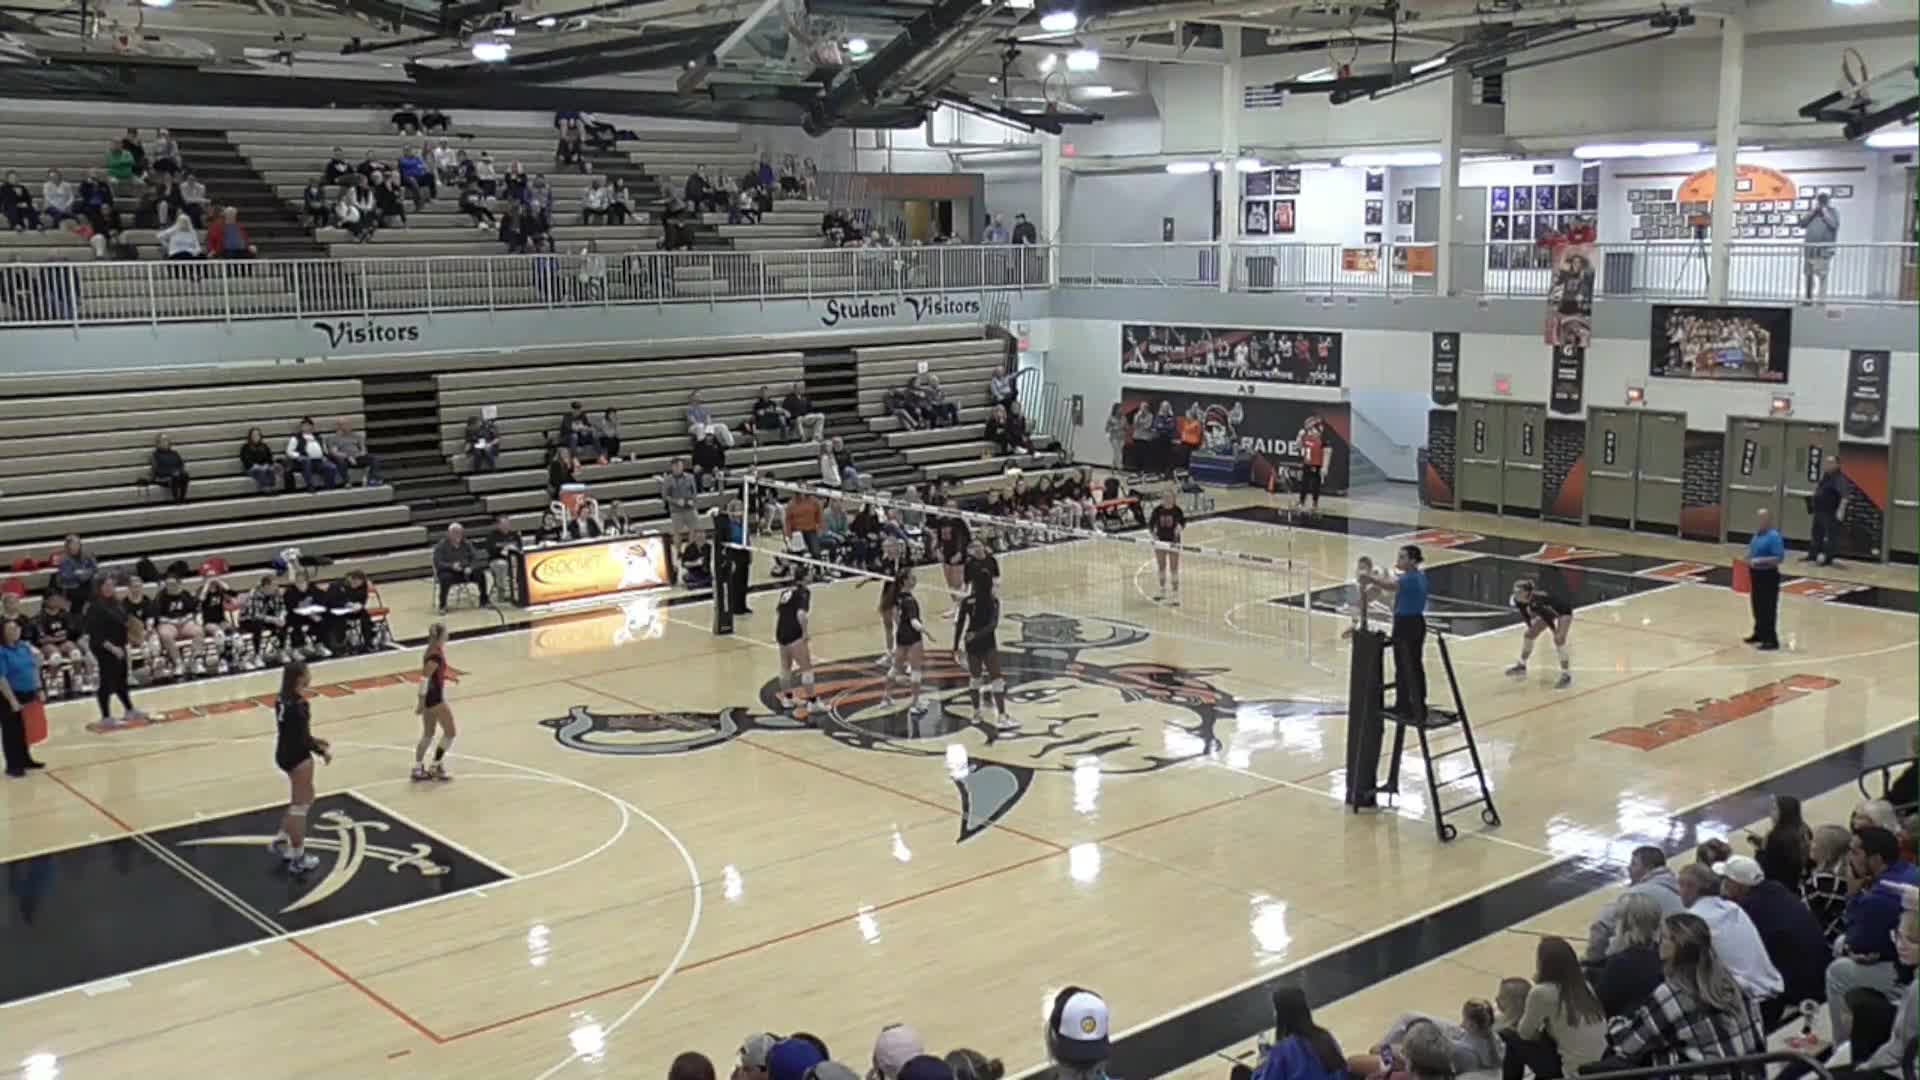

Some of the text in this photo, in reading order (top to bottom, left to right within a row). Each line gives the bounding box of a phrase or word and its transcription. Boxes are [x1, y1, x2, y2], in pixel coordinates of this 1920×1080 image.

[821, 297, 980, 327] Student Visitors
[313, 320, 420, 349] Visitors
[1240, 436, 1305, 457] RAIDE
